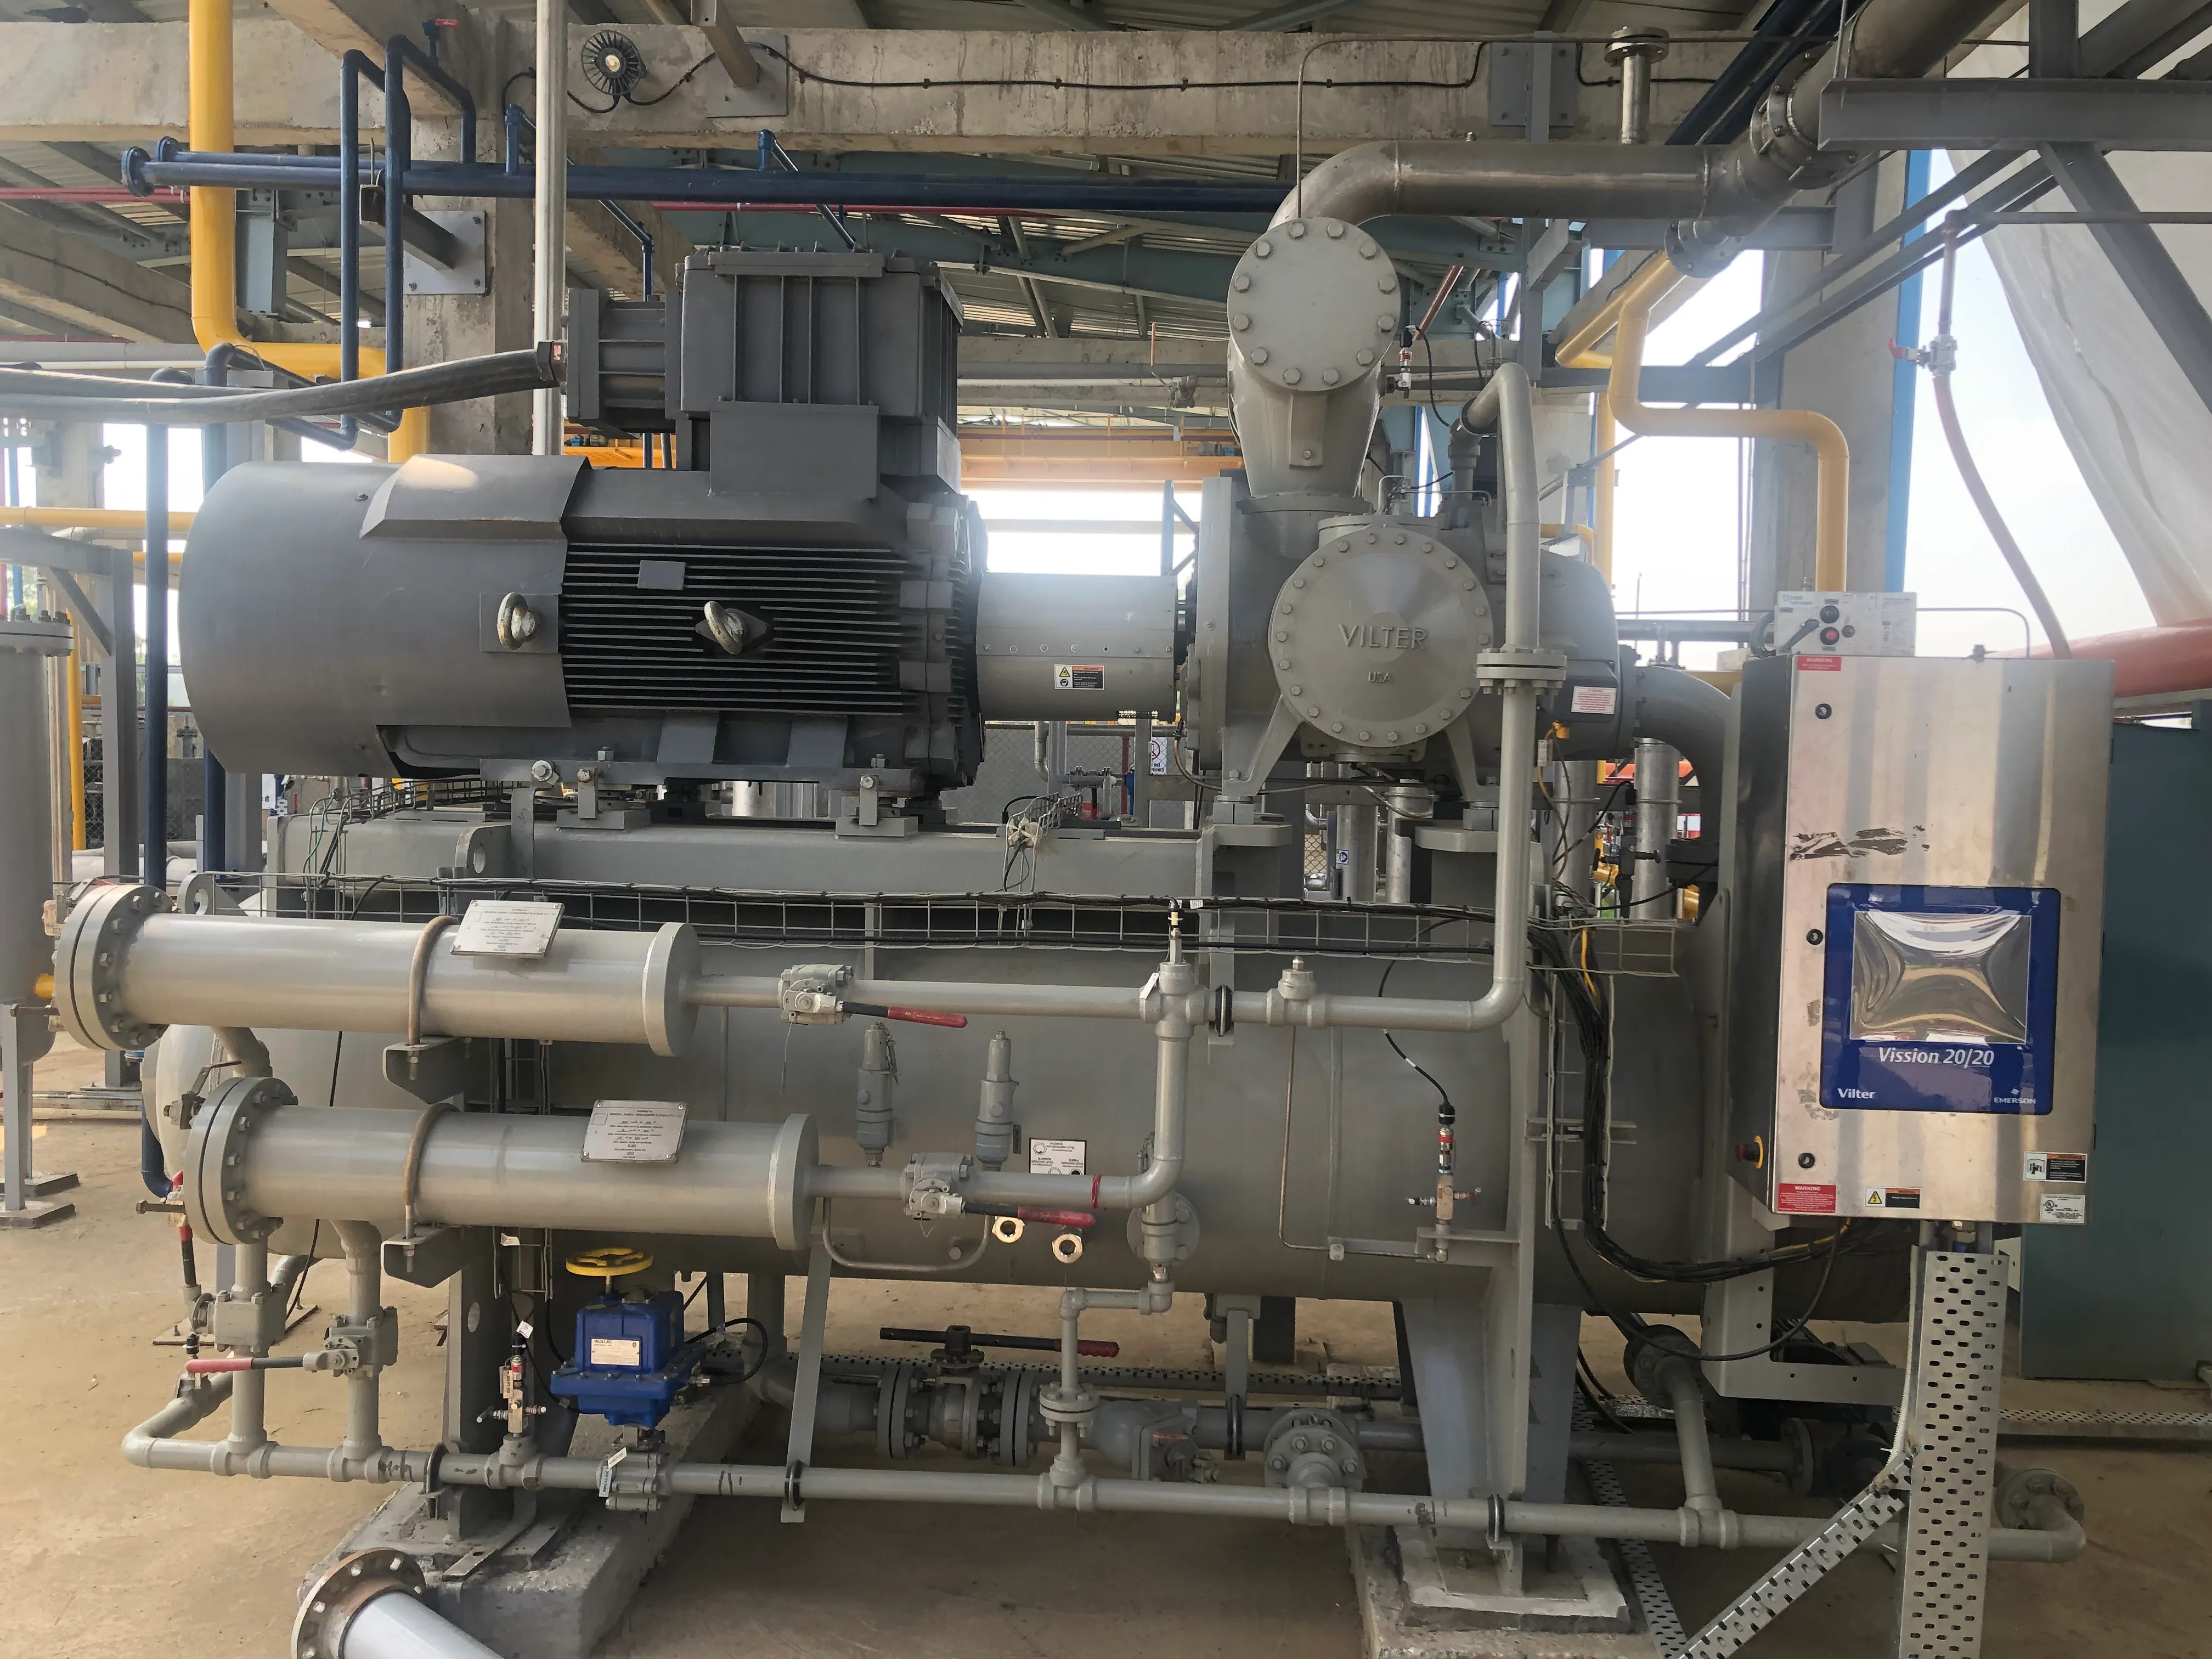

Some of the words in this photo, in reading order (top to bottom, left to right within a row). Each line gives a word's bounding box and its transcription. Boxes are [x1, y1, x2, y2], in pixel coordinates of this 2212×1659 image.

[1339, 624, 1427, 650] VILTER
[1368, 672, 1390, 683] USA
[1878, 1046, 1939, 1064] Vission
[1942, 1048, 1995, 1069] 20/20
[1837, 1088, 1876, 1099] Vilter
